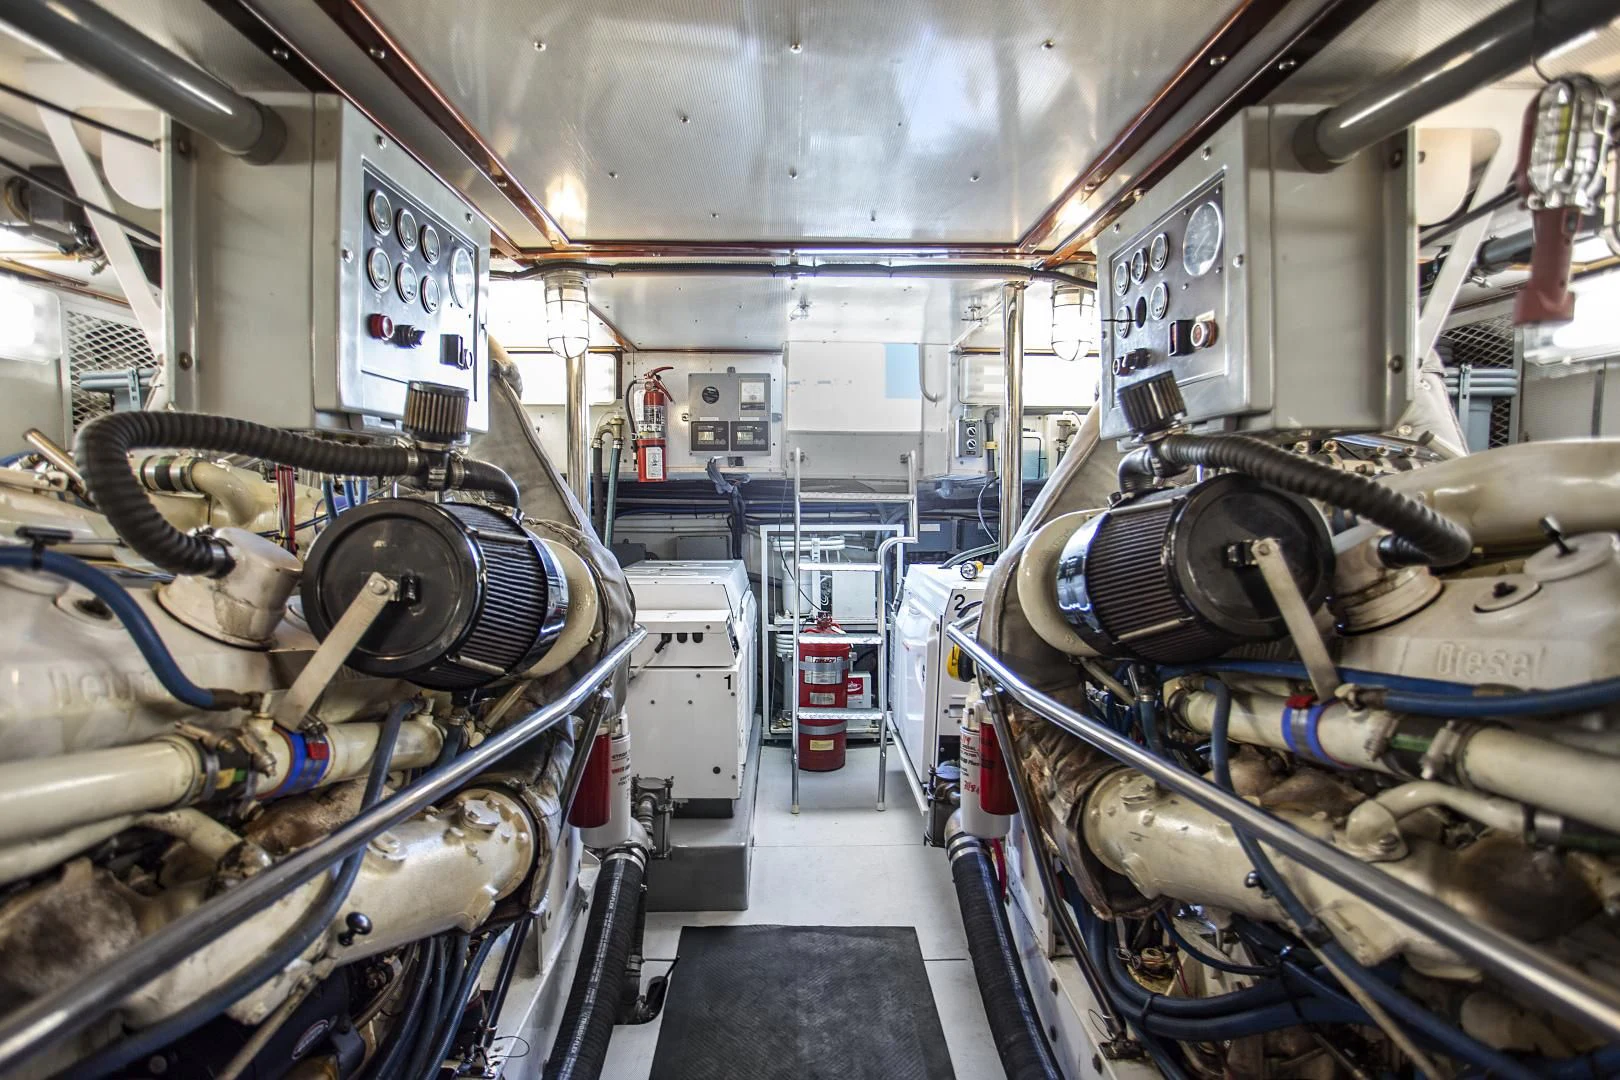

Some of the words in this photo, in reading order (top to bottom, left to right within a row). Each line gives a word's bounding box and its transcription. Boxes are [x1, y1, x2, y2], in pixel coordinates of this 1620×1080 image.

[954, 594, 965, 610] 2
[1437, 642, 1547, 680] Diesel
[724, 674, 731, 690] 1
